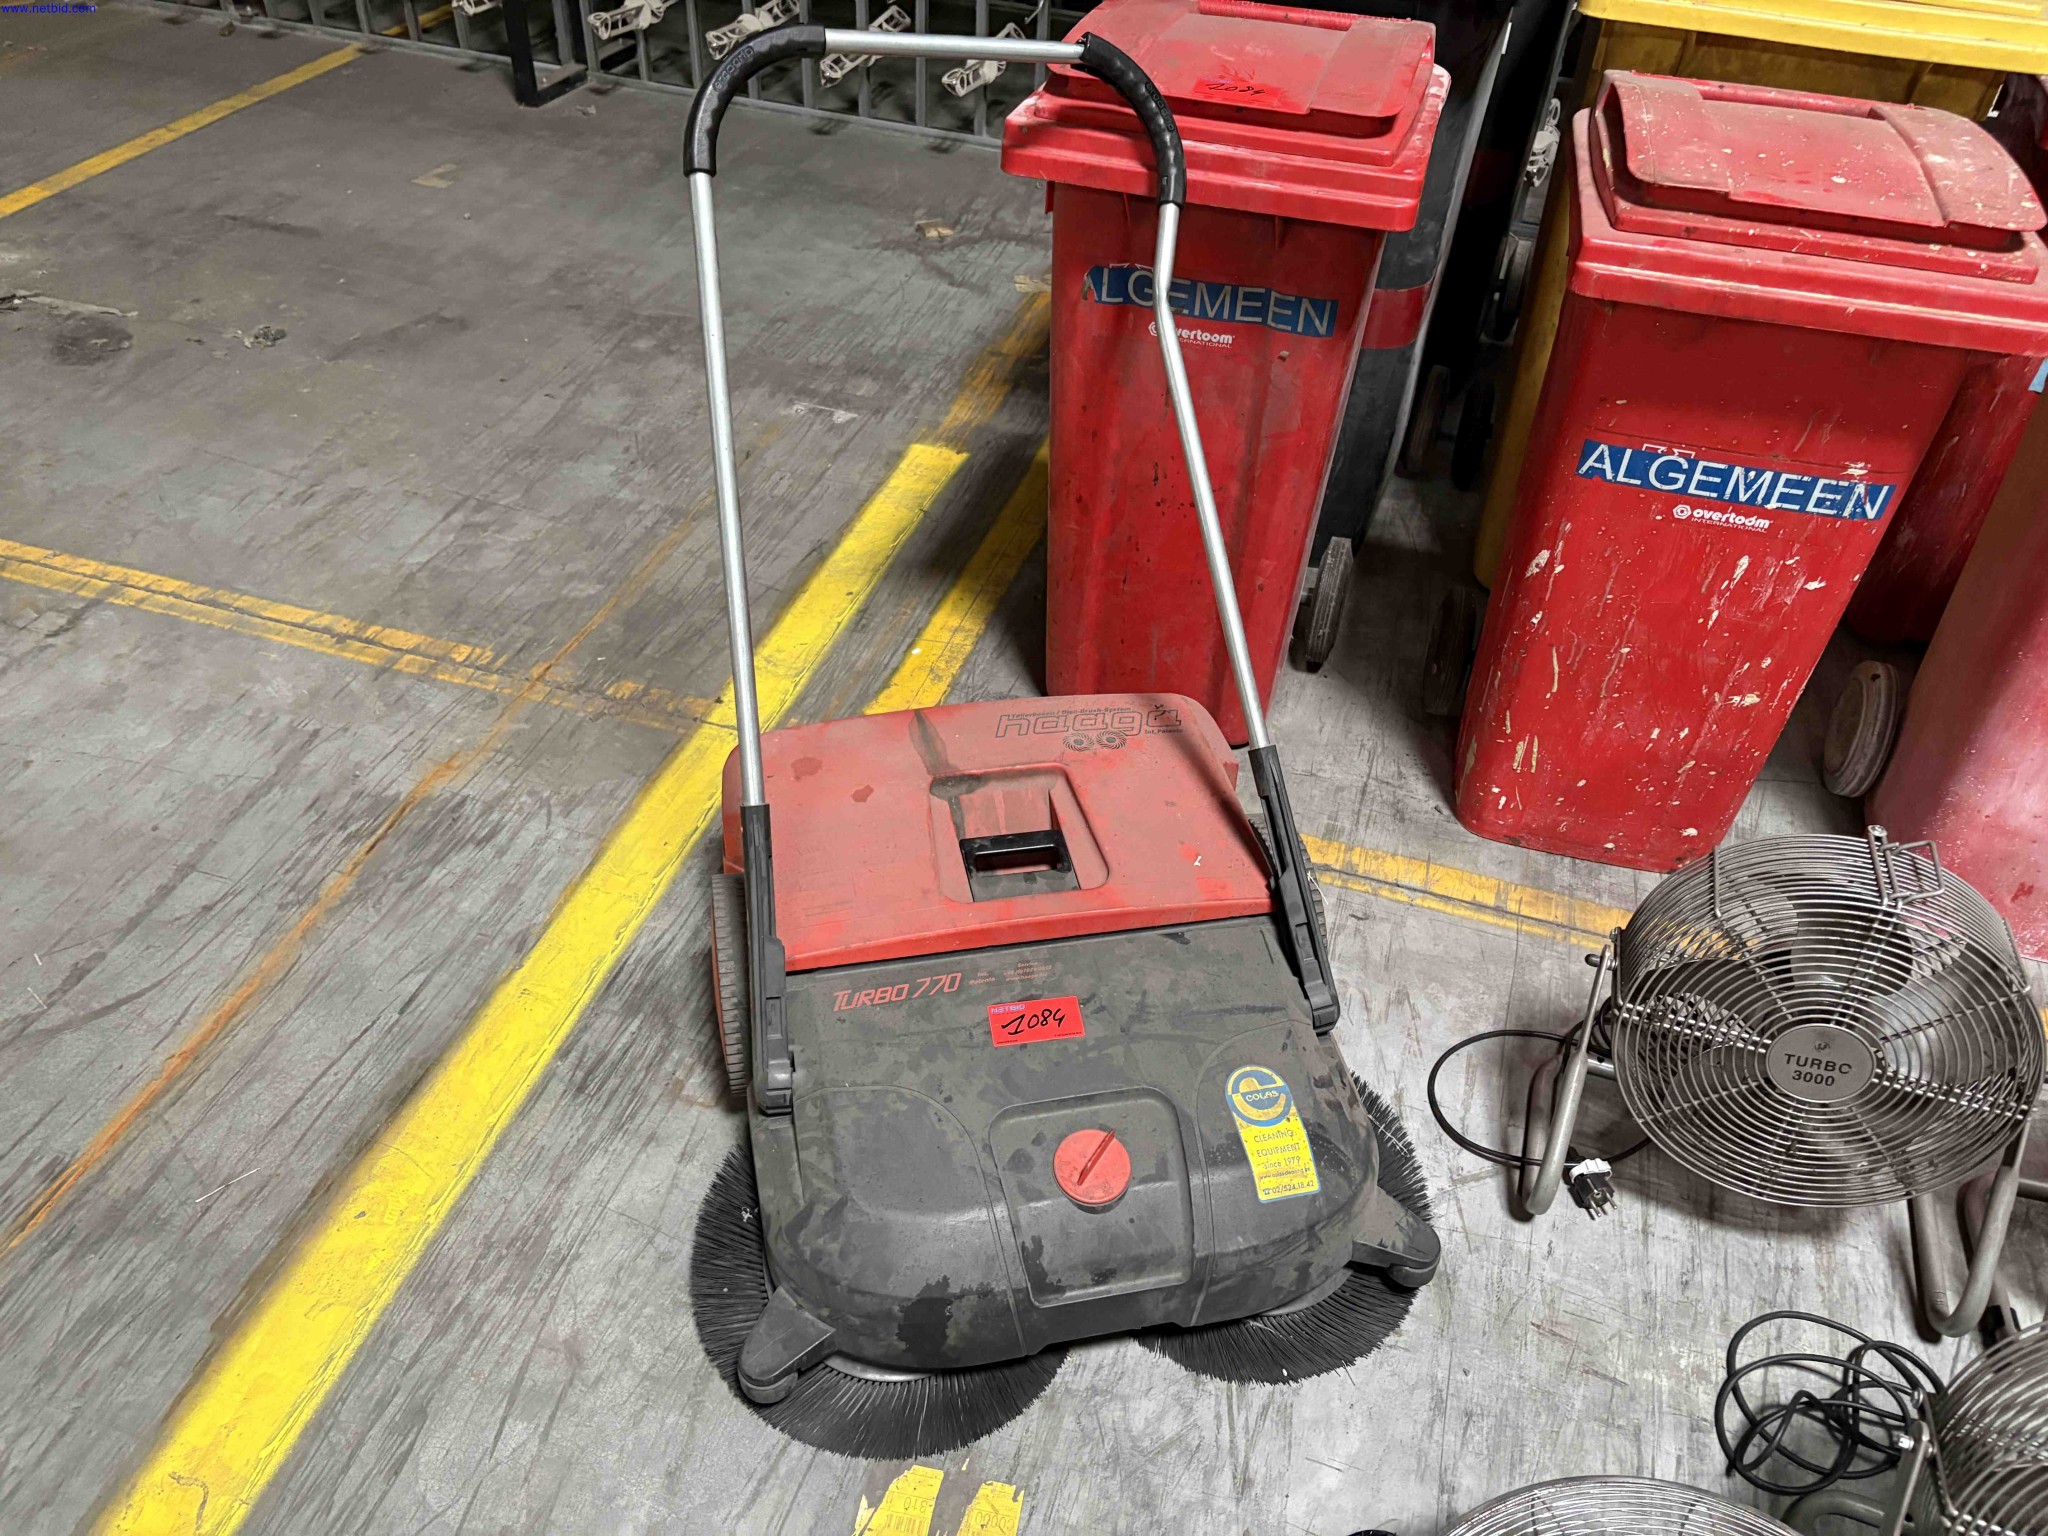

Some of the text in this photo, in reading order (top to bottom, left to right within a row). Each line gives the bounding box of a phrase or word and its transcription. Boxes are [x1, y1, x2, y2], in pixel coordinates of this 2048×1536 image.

[1174, 328, 1233, 344] vertoom
[1578, 443, 1889, 520] ALGEMEEN
[1691, 517, 1768, 534] INTERNATIONAL
[1693, 508, 1770, 529] overtoom
[996, 709, 1182, 739] haaga
[833, 972, 963, 1012] TURBO 770
[1001, 1008, 1066, 1036] 1084
[1792, 1070, 1836, 1087] 3000
[1246, 1090, 1280, 1102] COLAS
[1253, 1129, 1295, 1143] CLEANING
[1256, 1142, 1301, 1158] EQUIPMENT
[1263, 1161, 1282, 1170] since
